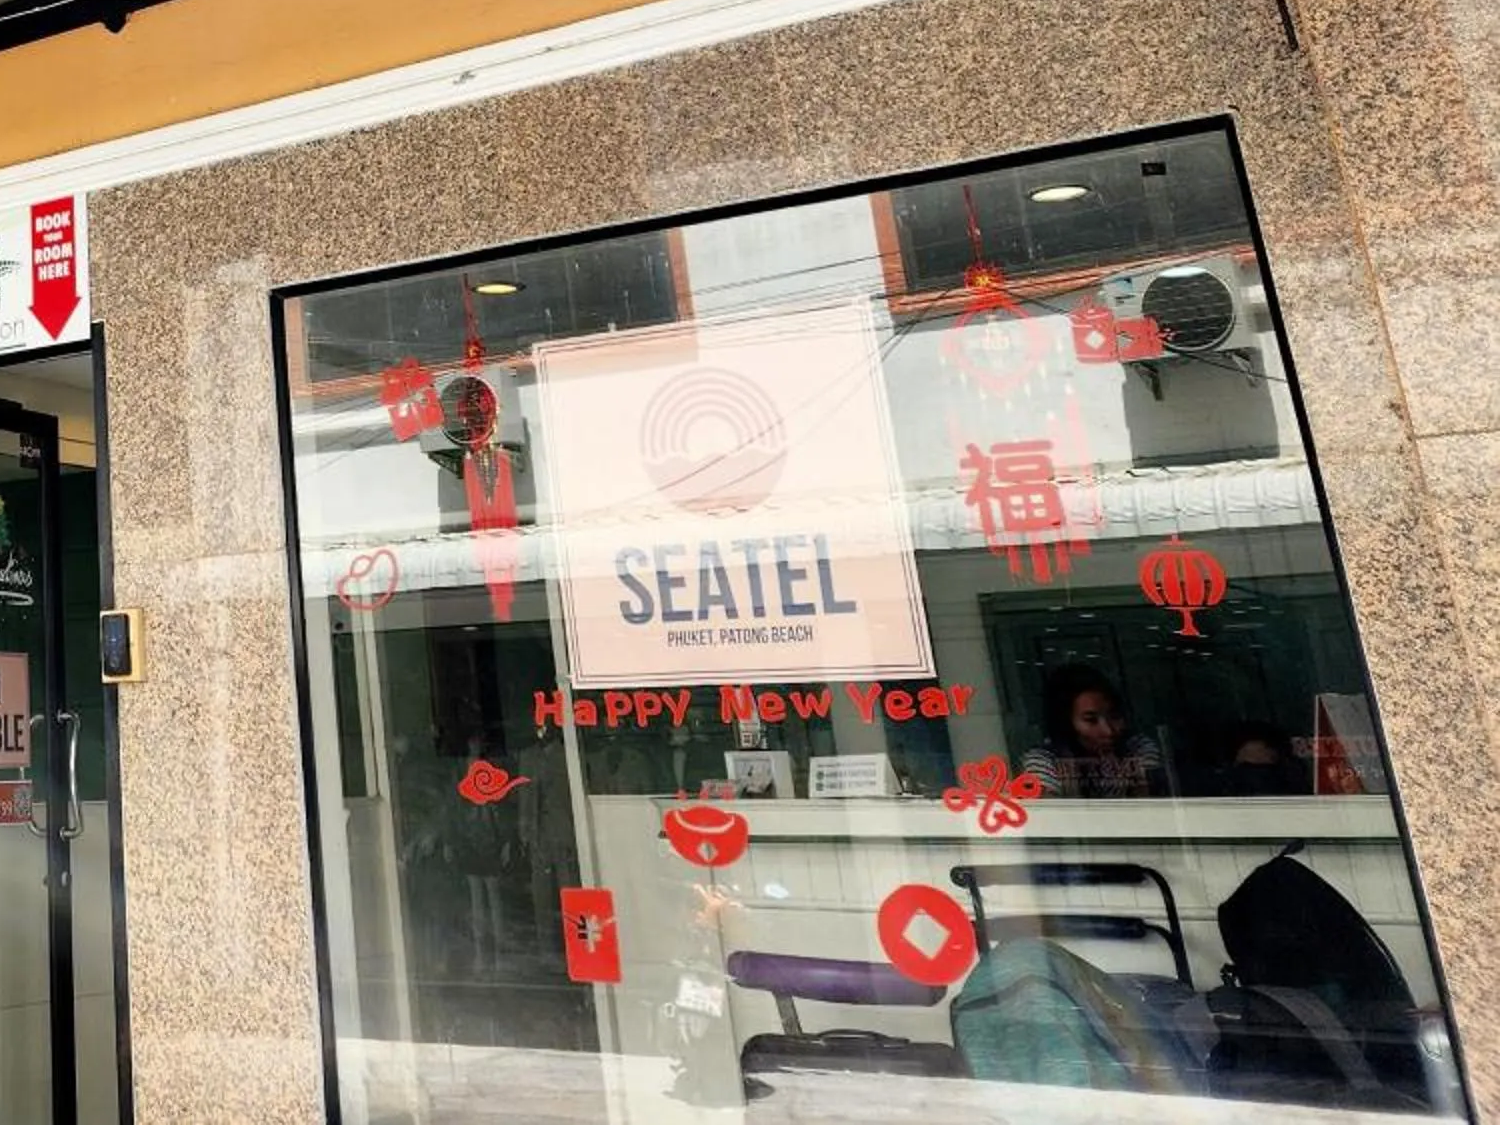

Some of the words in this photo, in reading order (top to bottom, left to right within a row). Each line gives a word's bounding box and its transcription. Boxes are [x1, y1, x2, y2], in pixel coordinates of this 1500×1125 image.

[35, 211, 71, 233] BOOK
[34, 242, 73, 265] ROOM
[37, 260, 71, 282] HERE
[959, 439, 1067, 543] 福
[615, 533, 857, 626] SEATEL
[667, 627, 717, 648] PHUKET,
[719, 626, 769, 645] PATONG
[771, 624, 814, 644] BEACH
[719, 683, 834, 723] New
[845, 682, 976, 724] Year
